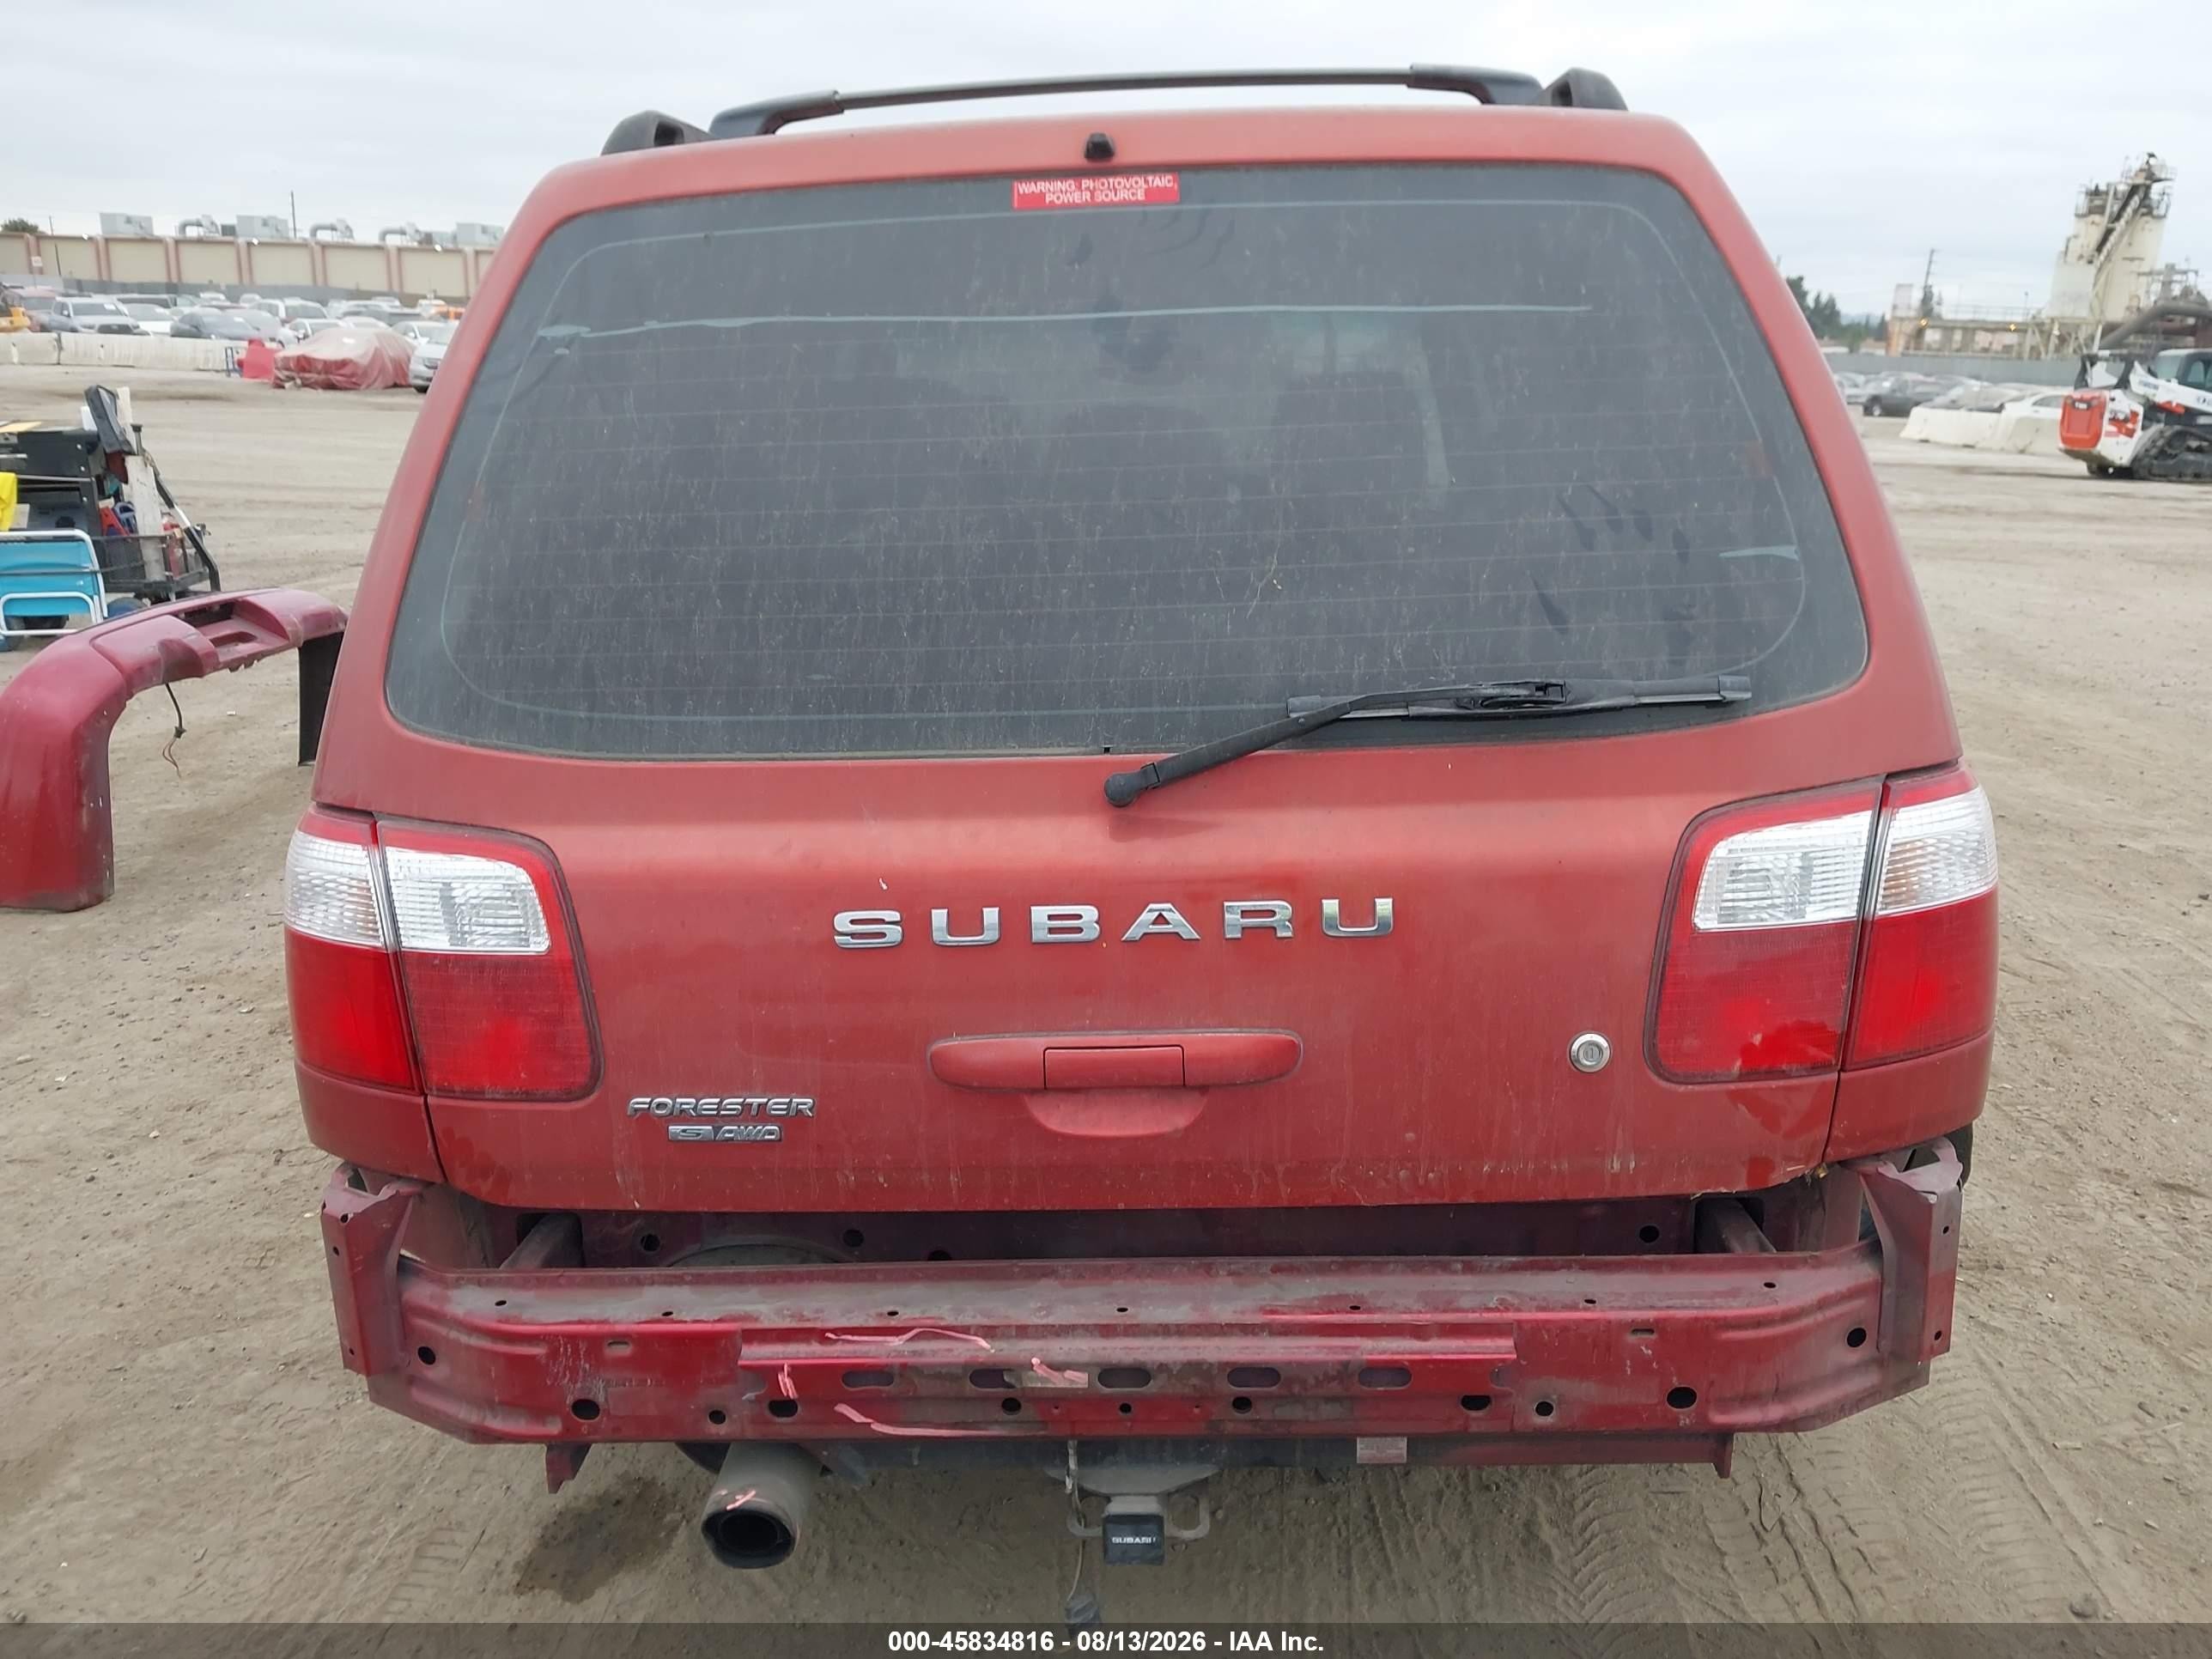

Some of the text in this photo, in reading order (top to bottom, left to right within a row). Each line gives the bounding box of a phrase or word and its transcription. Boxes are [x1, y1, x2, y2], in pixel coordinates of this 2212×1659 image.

[1081, 174, 1174, 191] PHOTOVOLTAIC
[1045, 188, 1146, 204] POWER SOURCE
[833, 897, 1395, 949] SUBARU
[628, 1097, 814, 1117] FORESTER
[715, 1125, 781, 1141] AWD
